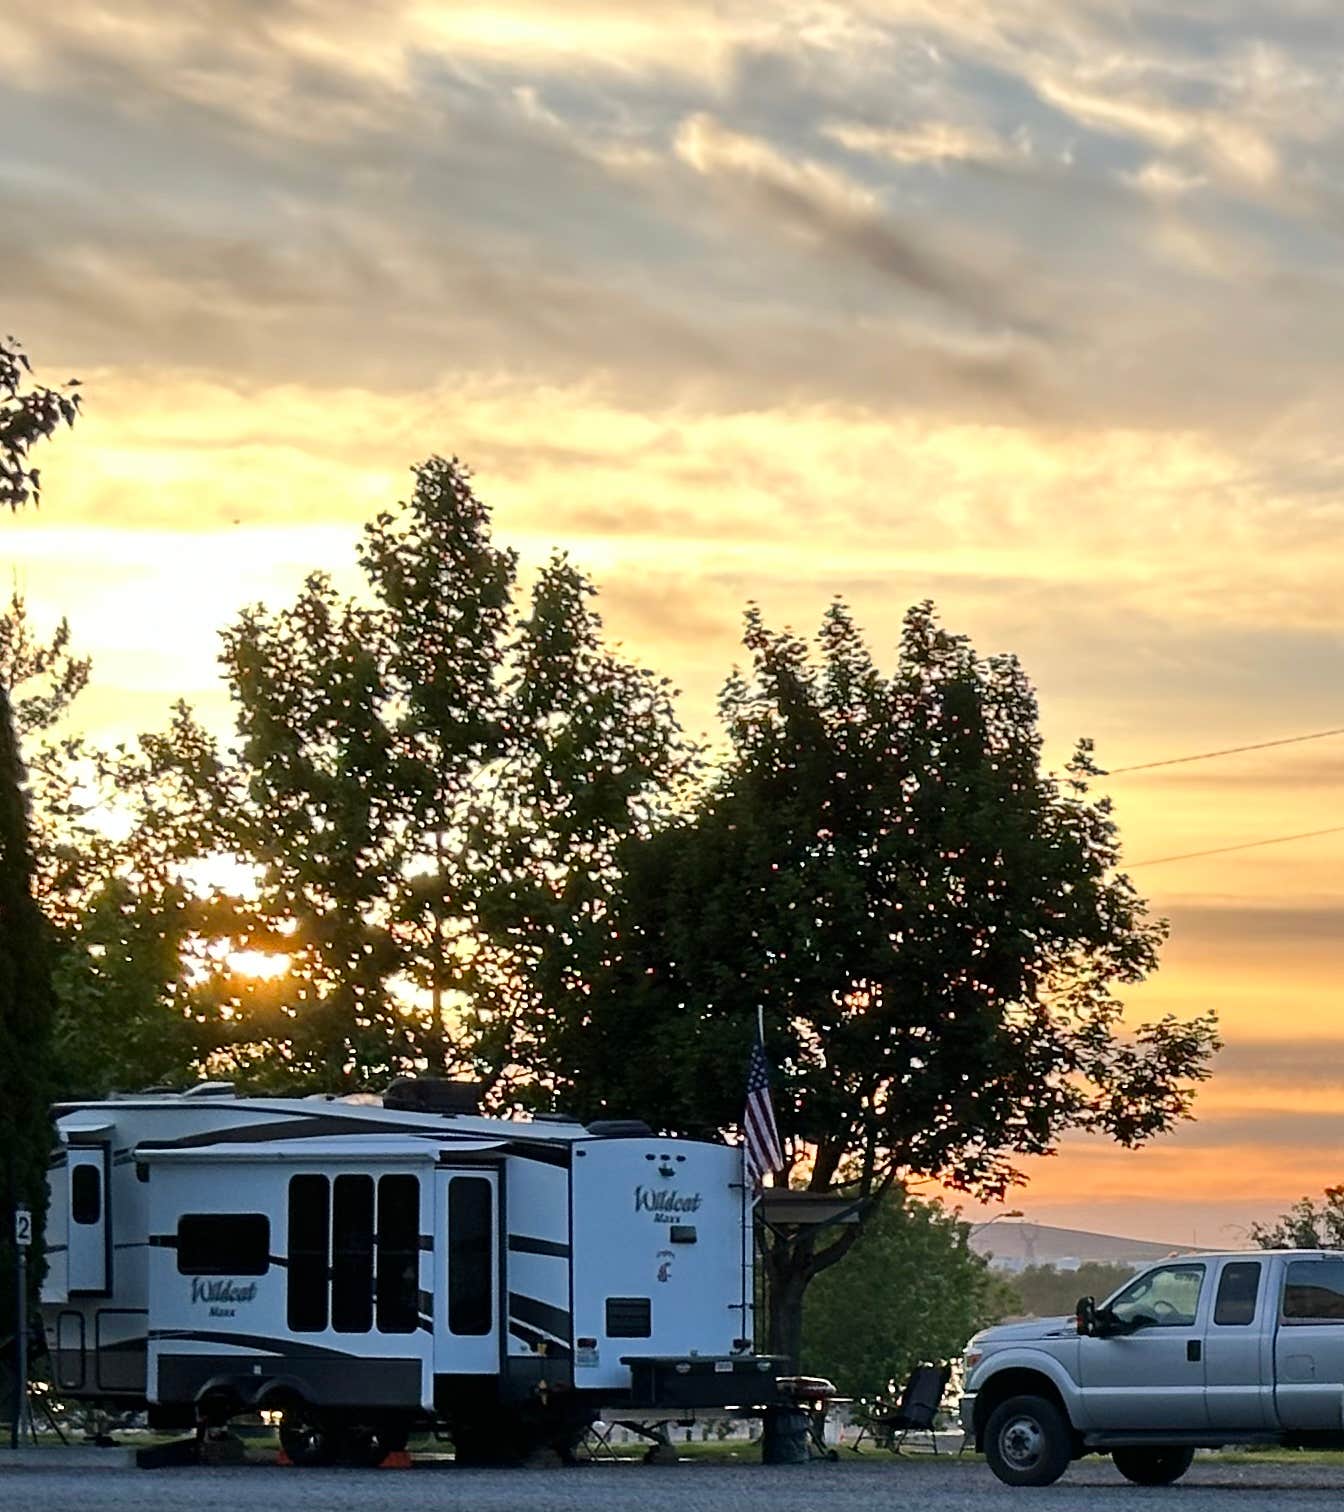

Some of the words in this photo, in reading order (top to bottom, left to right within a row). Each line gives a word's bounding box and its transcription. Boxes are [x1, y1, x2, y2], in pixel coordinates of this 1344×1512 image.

[634, 1185, 702, 1212] Wildcat
[19, 1216, 29, 1239] 2
[192, 1277, 258, 1304] Wildcat
